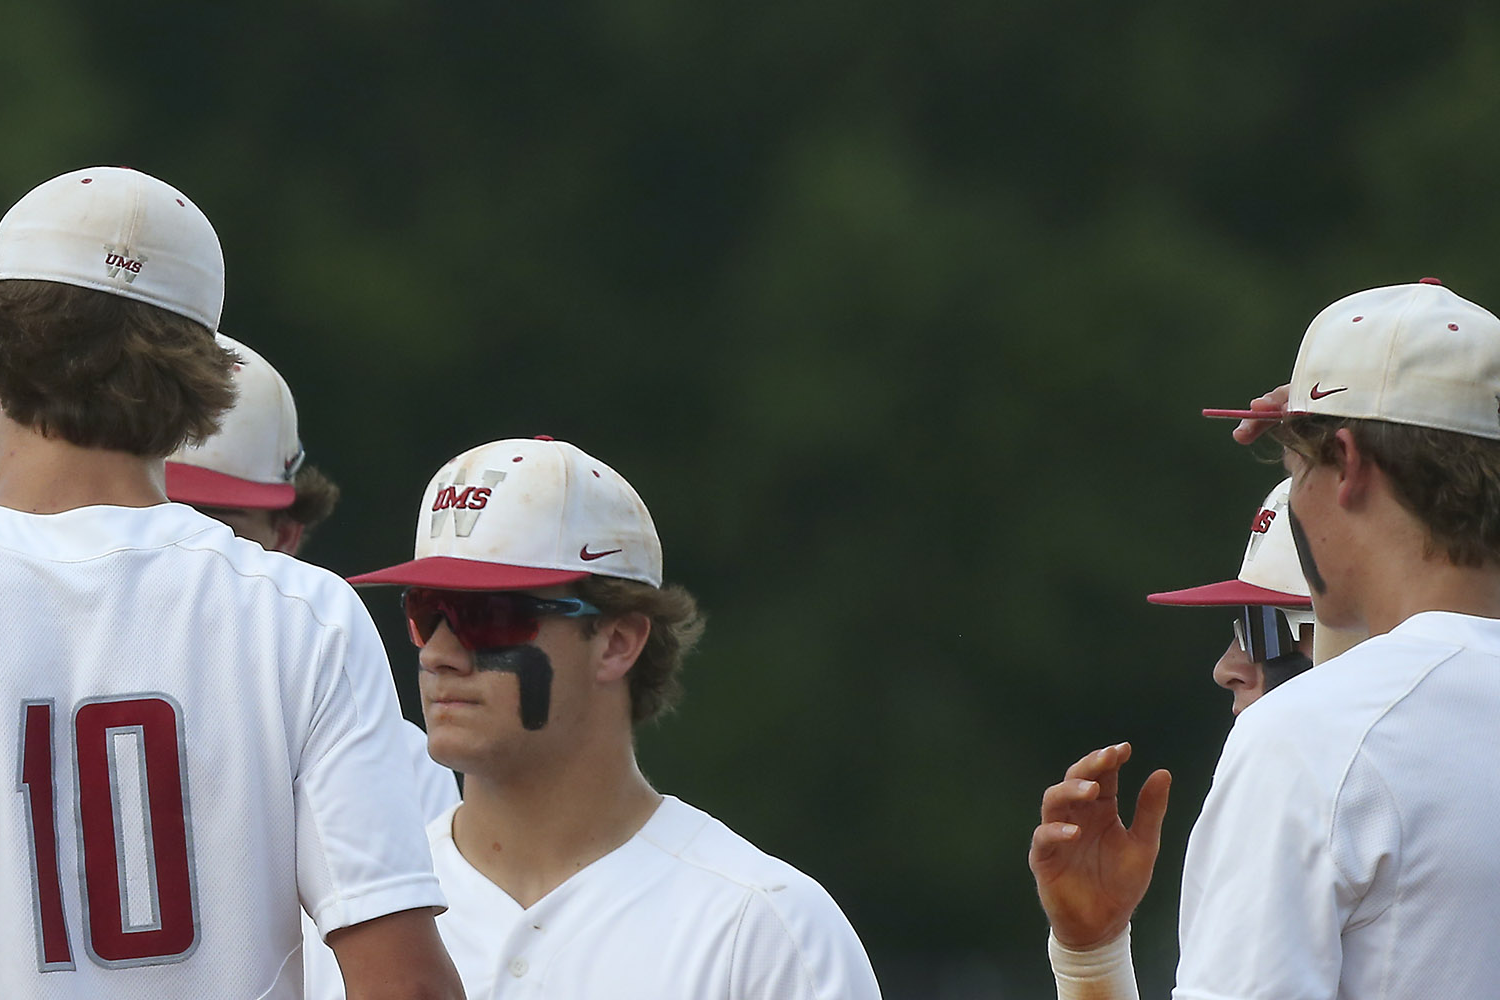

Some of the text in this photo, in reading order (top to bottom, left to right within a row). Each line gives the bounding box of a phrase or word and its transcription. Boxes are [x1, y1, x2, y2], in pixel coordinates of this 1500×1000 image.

[105, 253, 143, 273] UMS
[432, 486, 492, 512] UMS
[15, 691, 201, 973] 10
